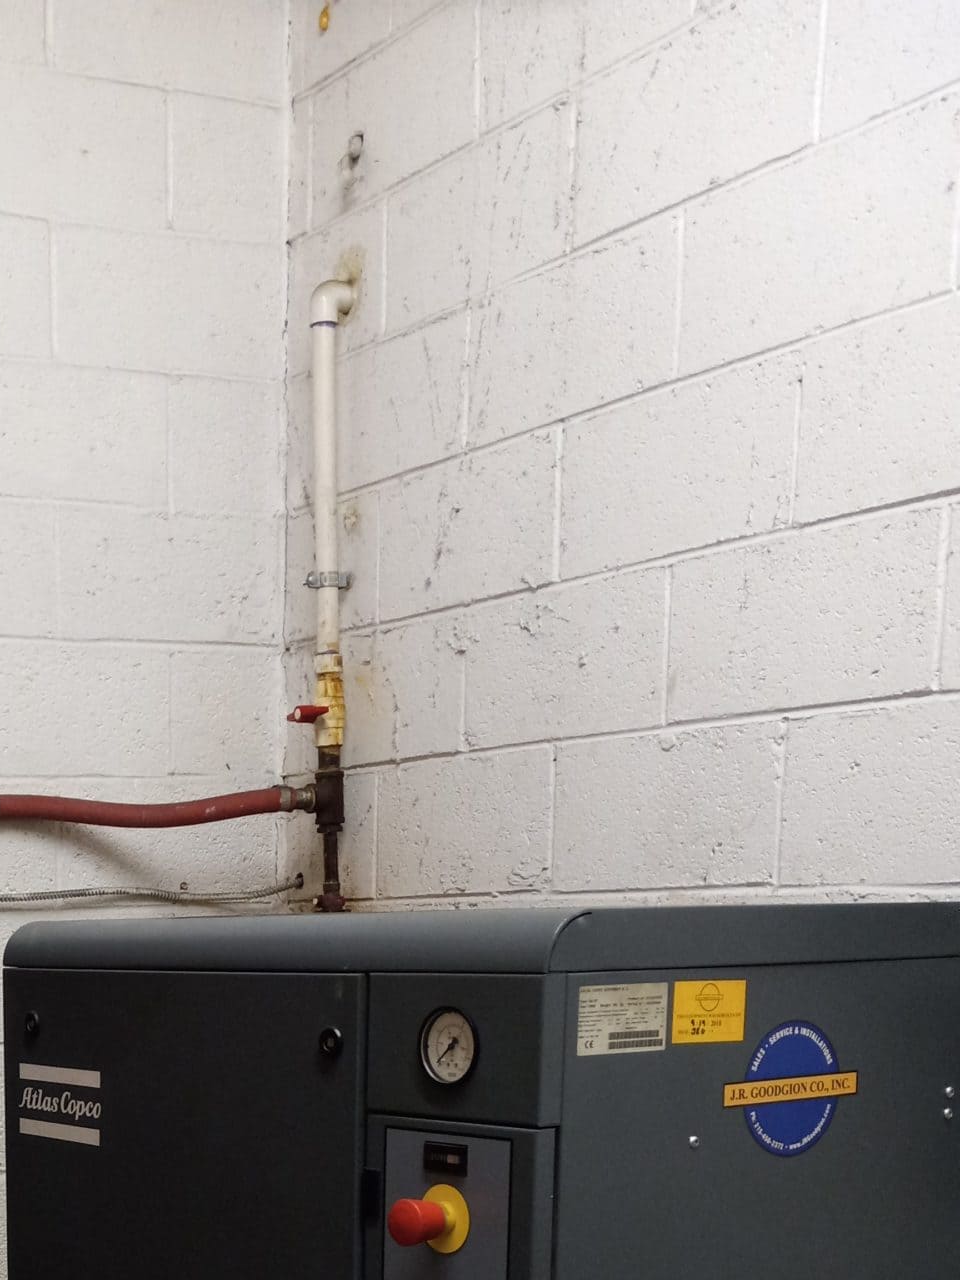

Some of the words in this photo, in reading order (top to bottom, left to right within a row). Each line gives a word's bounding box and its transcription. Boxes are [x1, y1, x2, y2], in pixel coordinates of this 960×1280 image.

[751, 1047, 766, 1072] SALES
[768, 1026, 793, 1045] SERVICE
[794, 1026, 800, 1035] &
[800, 1026, 833, 1065] INSTALLATIONS
[19, 1087, 59, 1113] Atlas
[60, 1091, 102, 1120] Copco
[730, 1088, 748, 1101] J.R.
[750, 1081, 808, 1099] GOODGION
[809, 1080, 829, 1093] CO.,
[831, 1078, 851, 1091] INC.
